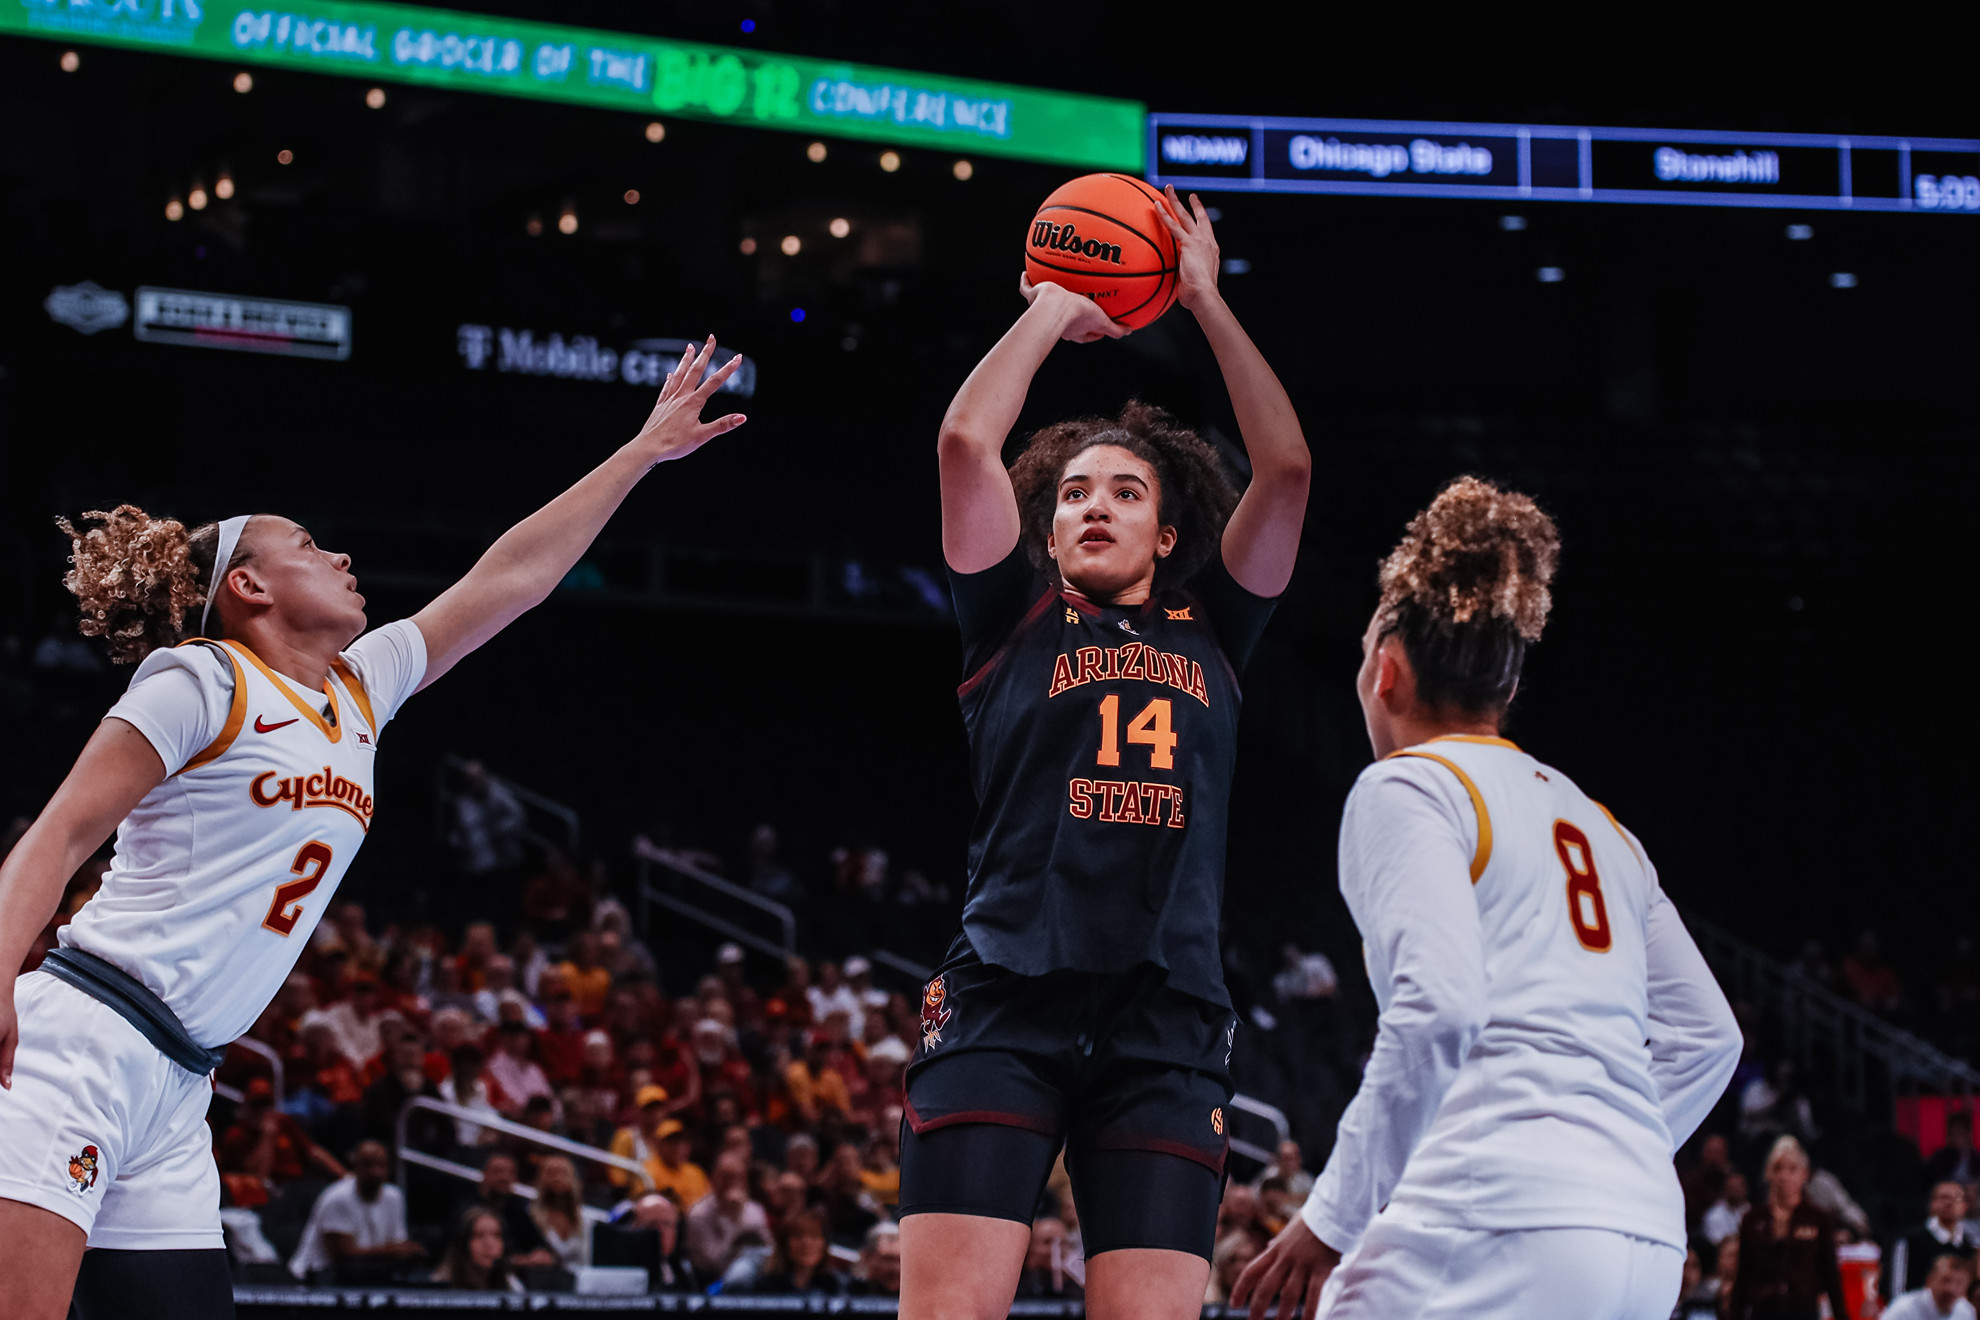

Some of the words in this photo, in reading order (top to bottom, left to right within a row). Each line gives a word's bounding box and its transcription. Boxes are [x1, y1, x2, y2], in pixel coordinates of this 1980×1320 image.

[1289, 135, 1409, 177] Chicago
[1410, 139, 1493, 175] State
[1032, 219, 1122, 265] Wilson
[498, 327, 619, 382] Mobile
[1048, 641, 1210, 708] ARIZONA
[1096, 693, 1179, 770] 14
[1069, 777, 1185, 828] STATE
[261, 839, 334, 938] 2
[1552, 818, 1613, 954] 8
